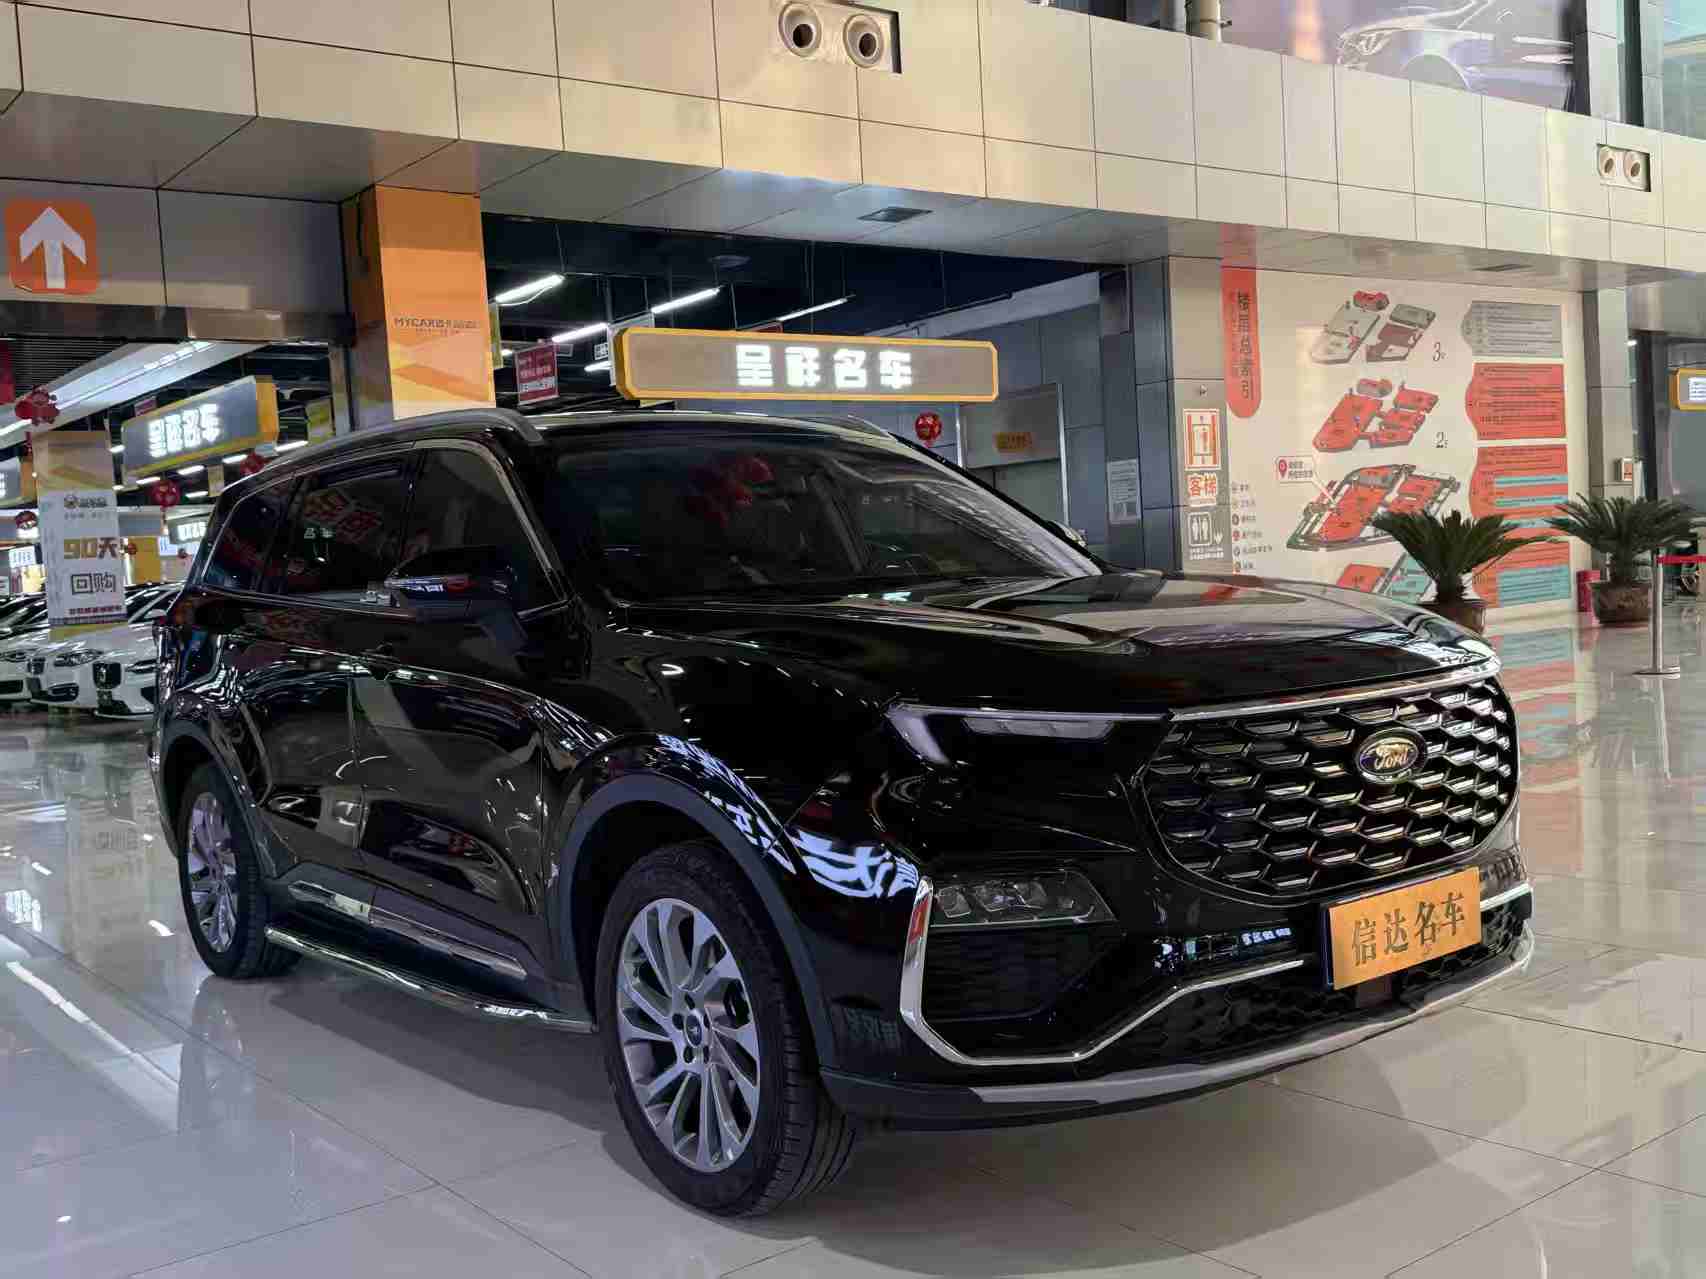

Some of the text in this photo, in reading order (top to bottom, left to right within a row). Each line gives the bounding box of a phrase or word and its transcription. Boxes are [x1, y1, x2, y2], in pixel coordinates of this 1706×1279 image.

[71, 572, 117, 595] 回购
[1351, 891, 1466, 967] 信达名车
